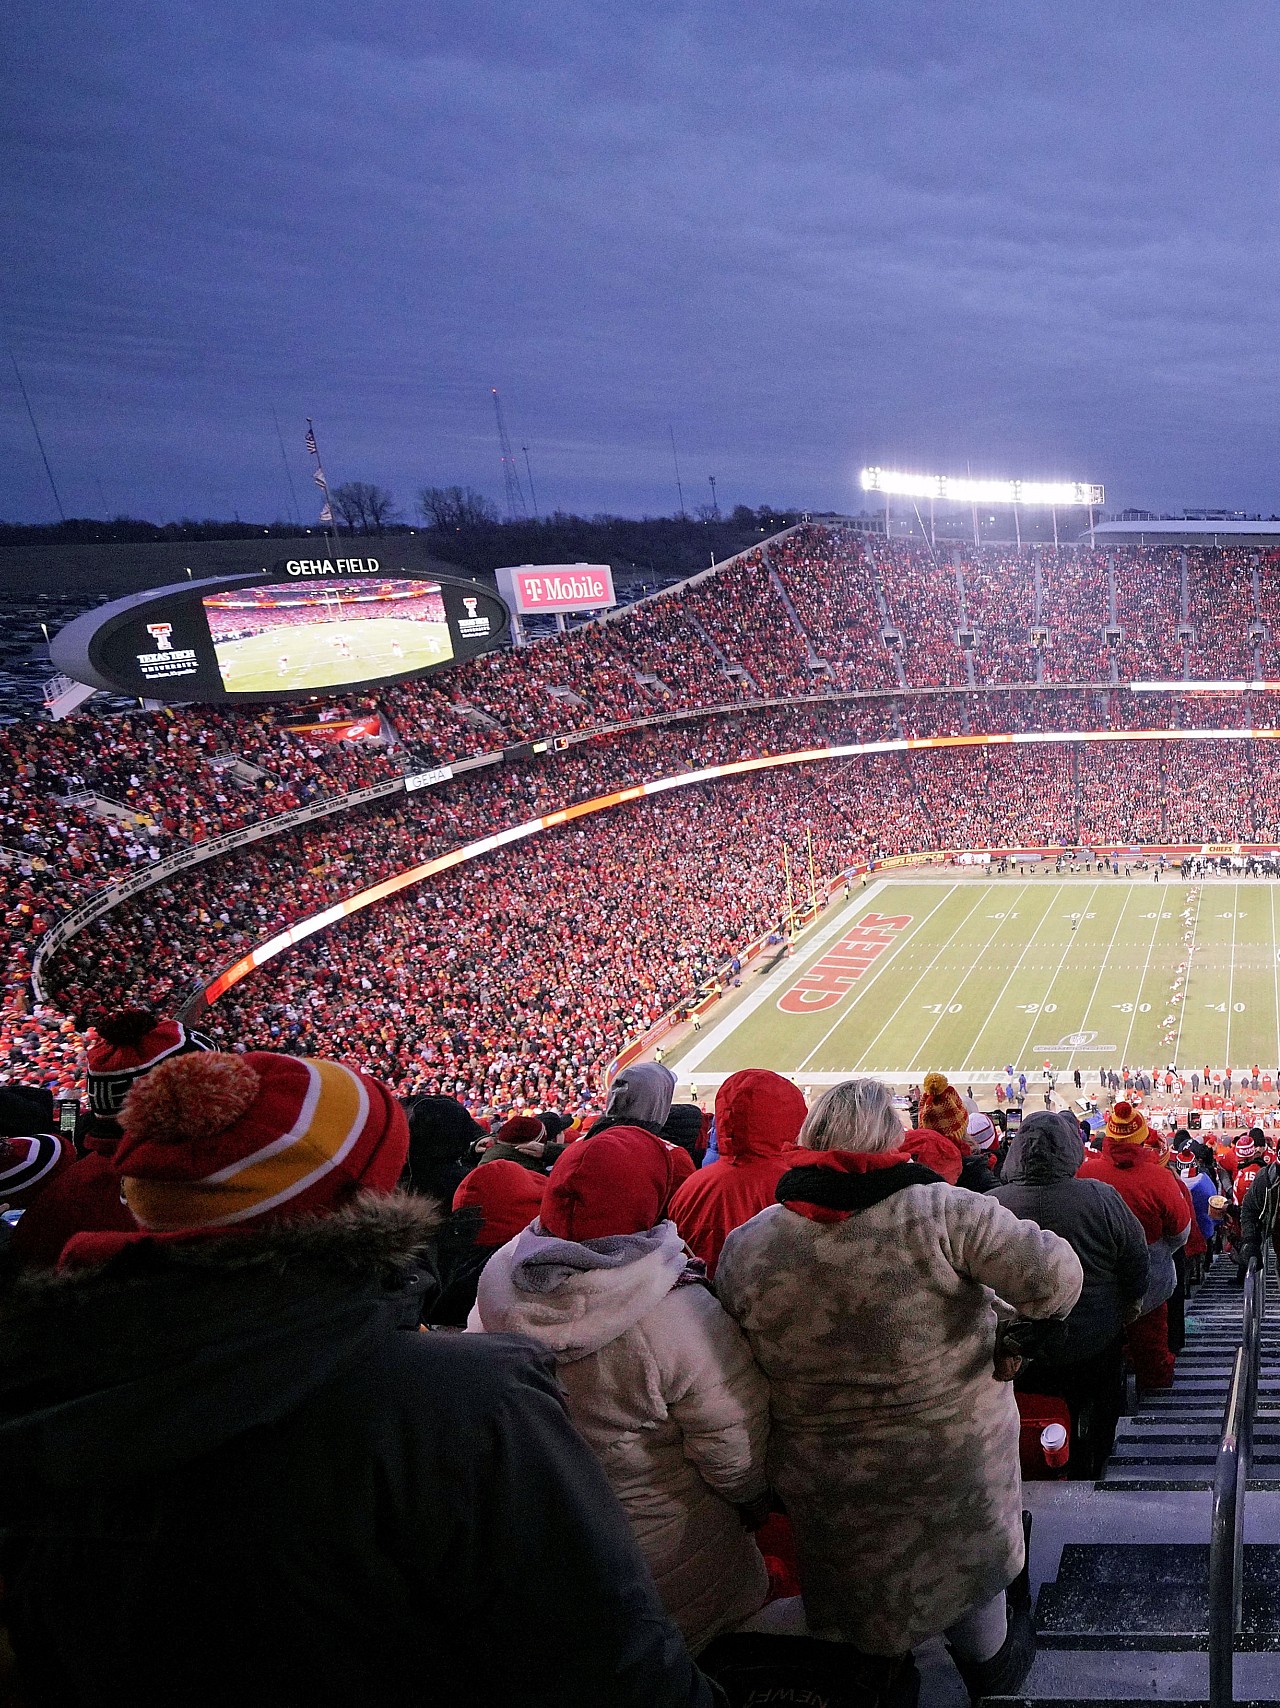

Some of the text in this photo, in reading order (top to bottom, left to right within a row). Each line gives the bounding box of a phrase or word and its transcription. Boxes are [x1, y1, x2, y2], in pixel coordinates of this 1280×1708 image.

[286, 558, 379, 575] GEHA FIELD
[136, 649, 196, 663] TEXAS TECH
[412, 769, 446, 788] GEHA
[372, 783, 394, 795] WILSON
[310, 798, 349, 816] HANK STRAM
[273, 814, 300, 829] THOMAS
[224, 832, 249, 848] LANIER
[776, 912, 914, 1014] CHIEFS
[932, 1002, 962, 1014] 10
[1025, 1002, 1057, 1013] 20
[1120, 1002, 1152, 1013] 30
[1214, 1002, 1245, 1013] 40
[1108, 1121, 1138, 1135] CHIEFS
